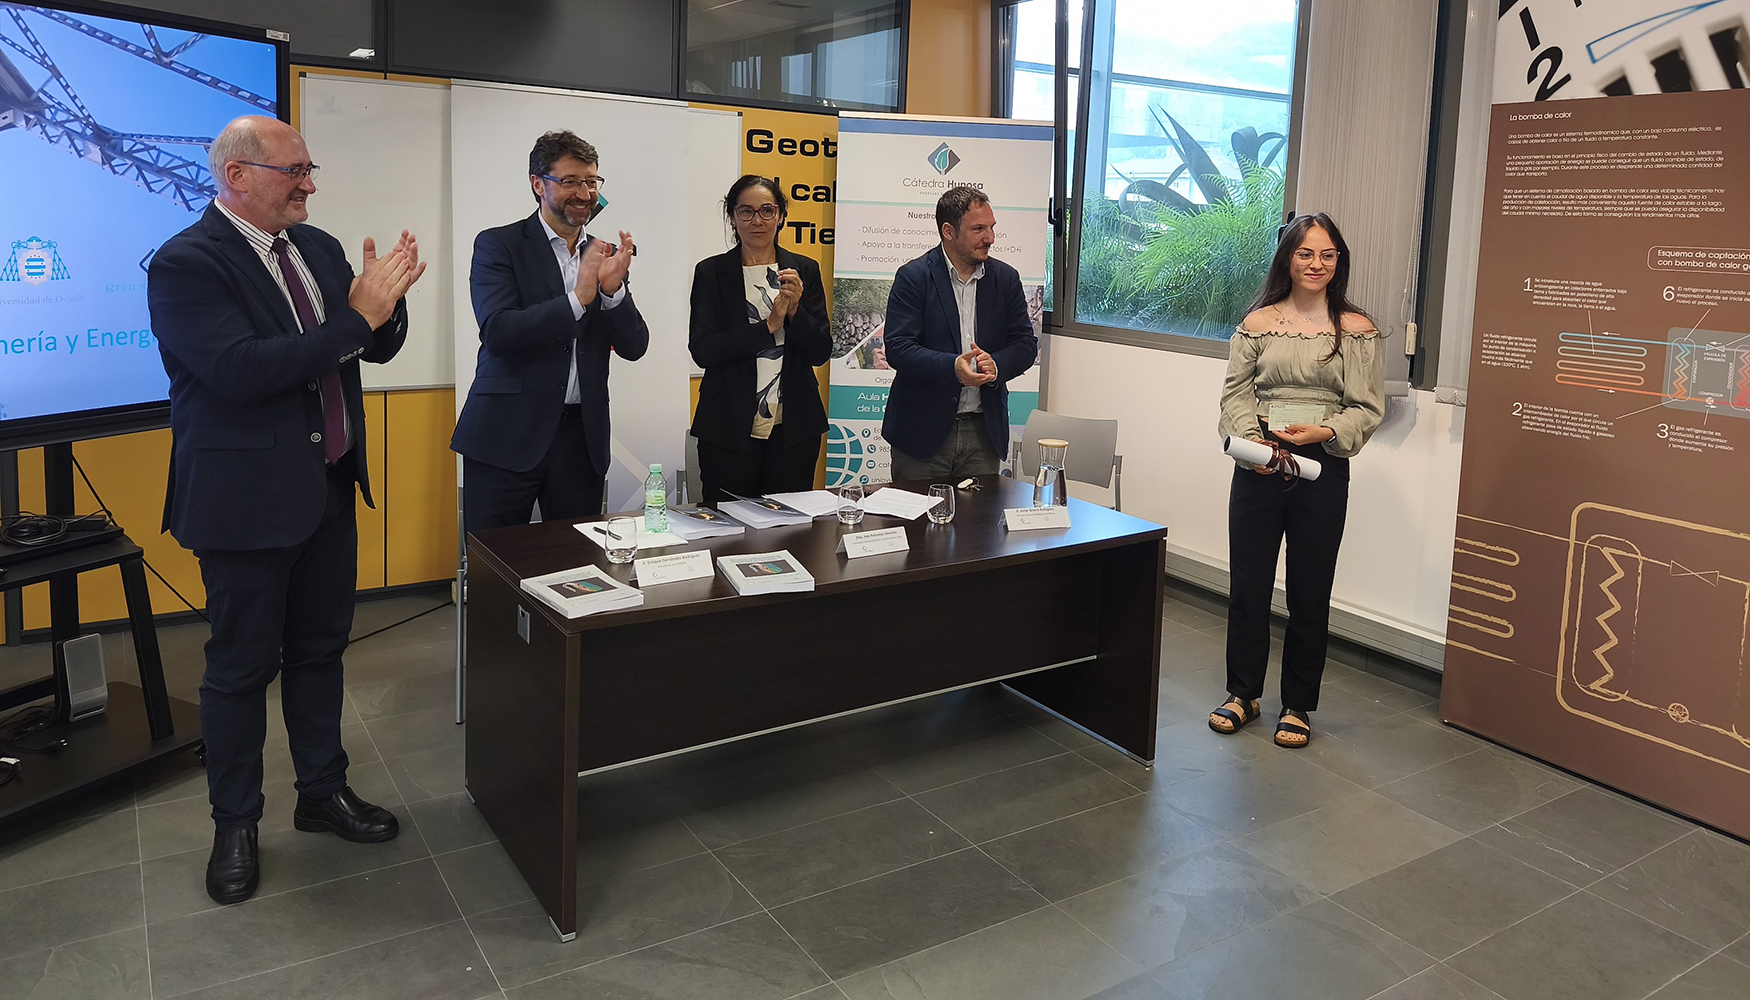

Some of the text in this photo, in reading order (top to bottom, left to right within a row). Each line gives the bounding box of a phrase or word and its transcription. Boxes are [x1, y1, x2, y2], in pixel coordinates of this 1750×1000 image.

[746, 129, 837, 158] Geot
[902, 178, 984, 189] Cátedra Hunosa
[787, 222, 835, 245] Tie
[862, 226, 889, 234] Difusión
[1523, 277, 1533, 292] 1
[43, 295, 54, 304] de
[55, 294, 85, 303] Oviedo
[1663, 286, 1675, 302] 6
[66, 335, 78, 354] y
[1512, 402, 1522, 416] 2
[1656, 423, 1668, 438] 3
